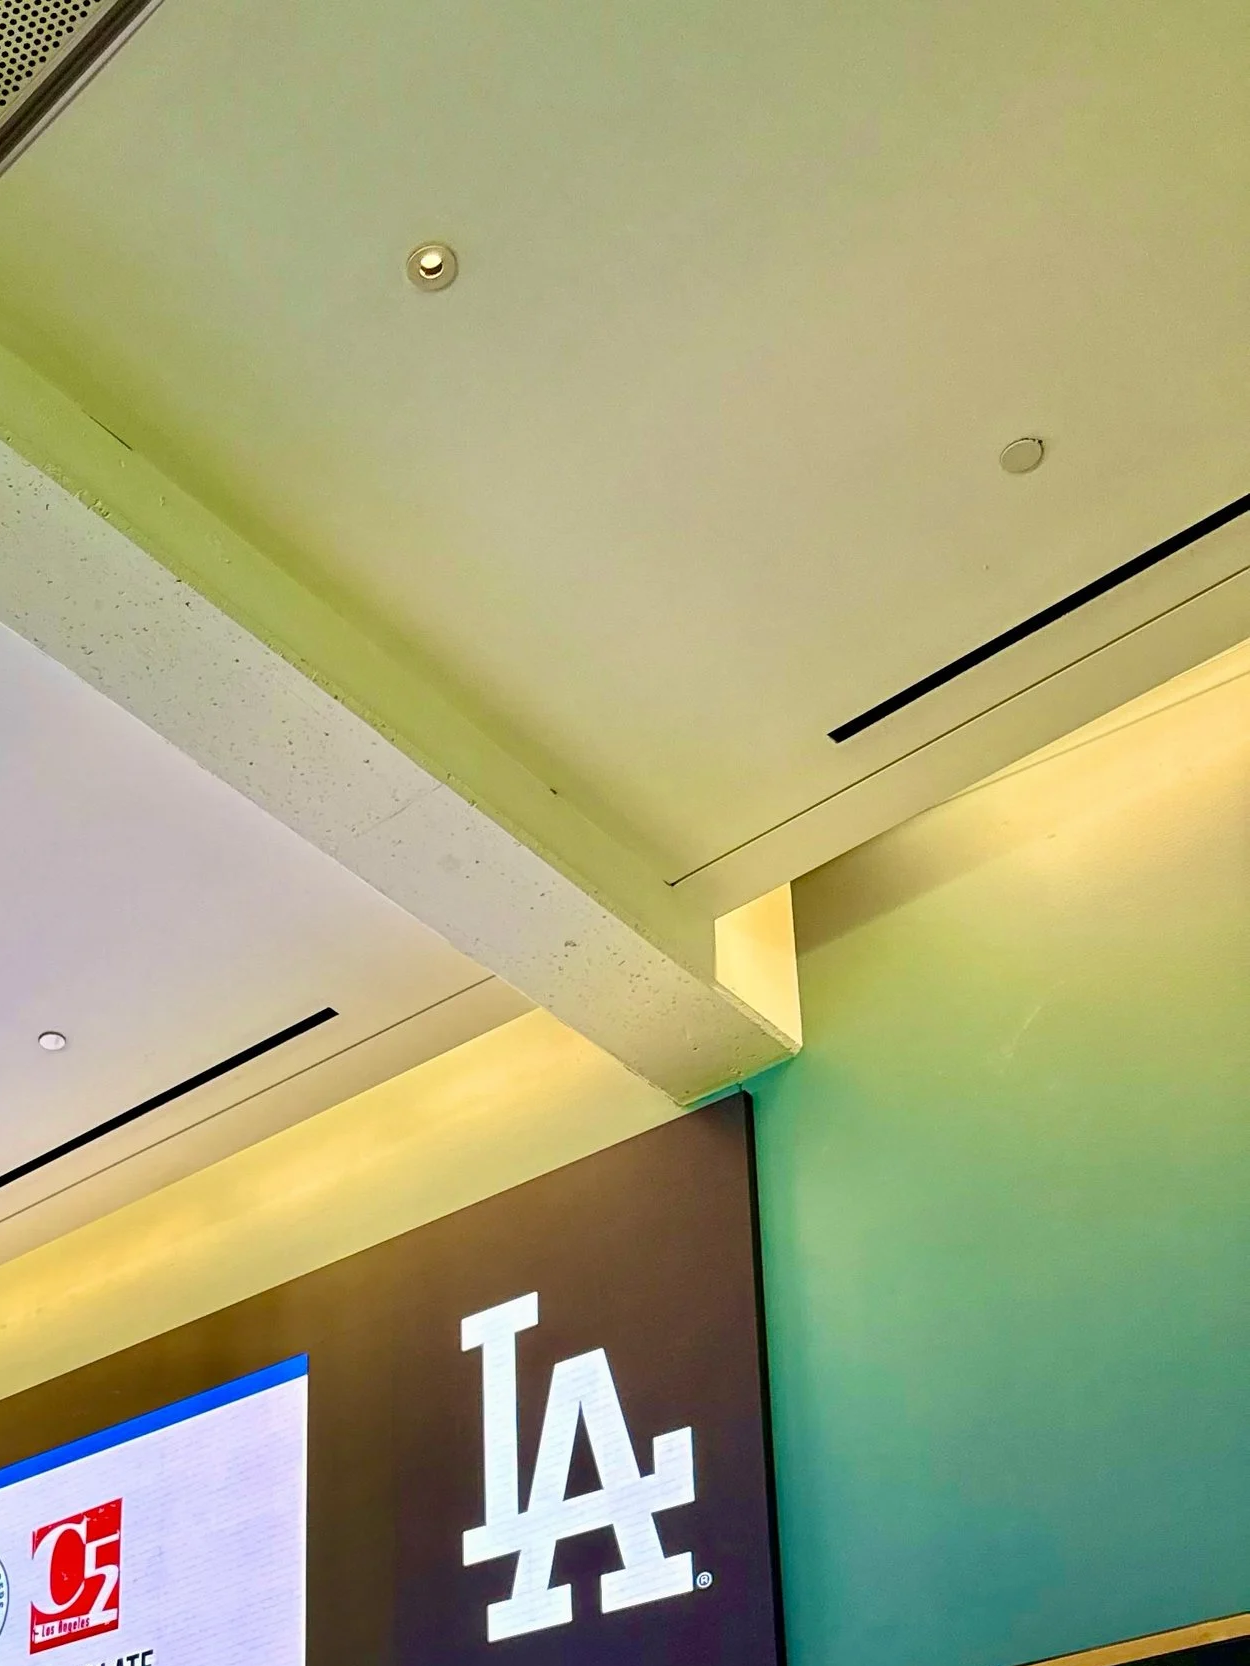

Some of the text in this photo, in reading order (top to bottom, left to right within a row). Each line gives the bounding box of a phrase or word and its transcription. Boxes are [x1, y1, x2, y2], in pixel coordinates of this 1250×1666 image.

[461, 1291, 695, 1642] LA
[41, 1617, 90, 1637] Los Angeles
